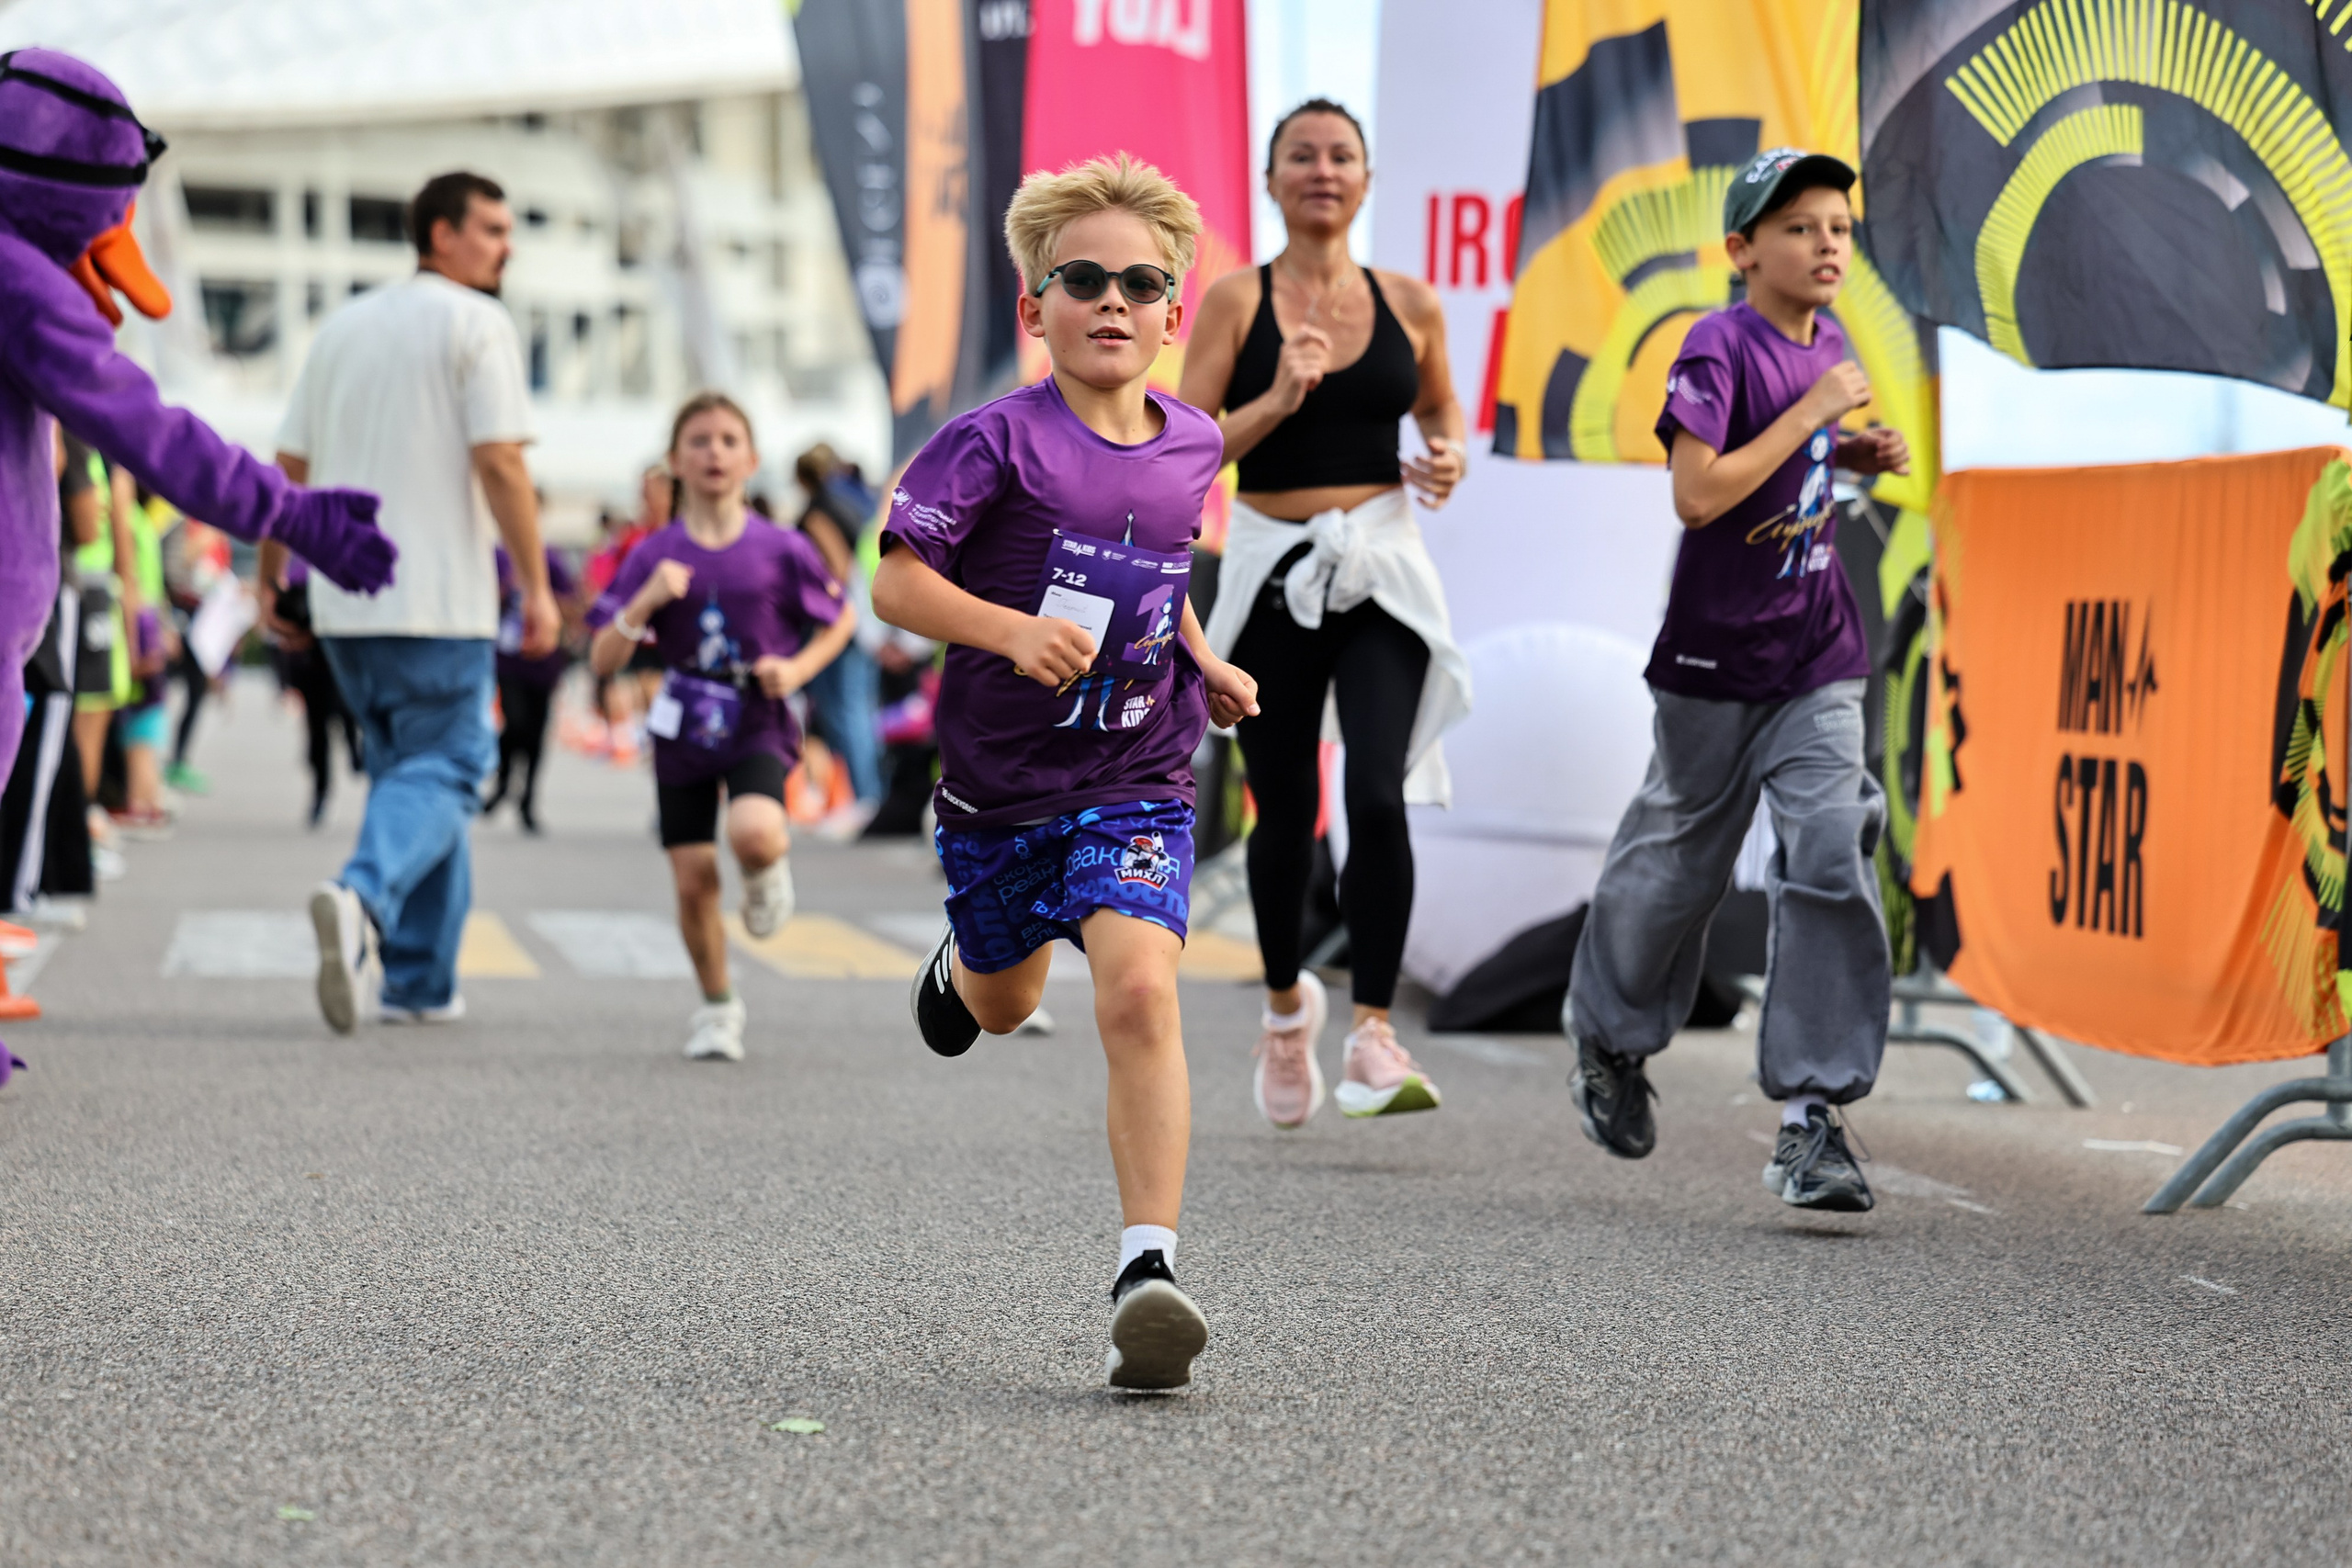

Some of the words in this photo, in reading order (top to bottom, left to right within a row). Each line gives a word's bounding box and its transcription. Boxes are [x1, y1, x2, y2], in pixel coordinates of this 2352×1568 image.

[1051, 567, 1088, 588] 7-12
[2057, 598, 2131, 736] MAN
[1124, 695, 1146, 710] STAR
[2048, 750, 2148, 939] STAR
[1120, 868, 1164, 886] МИХЛ
